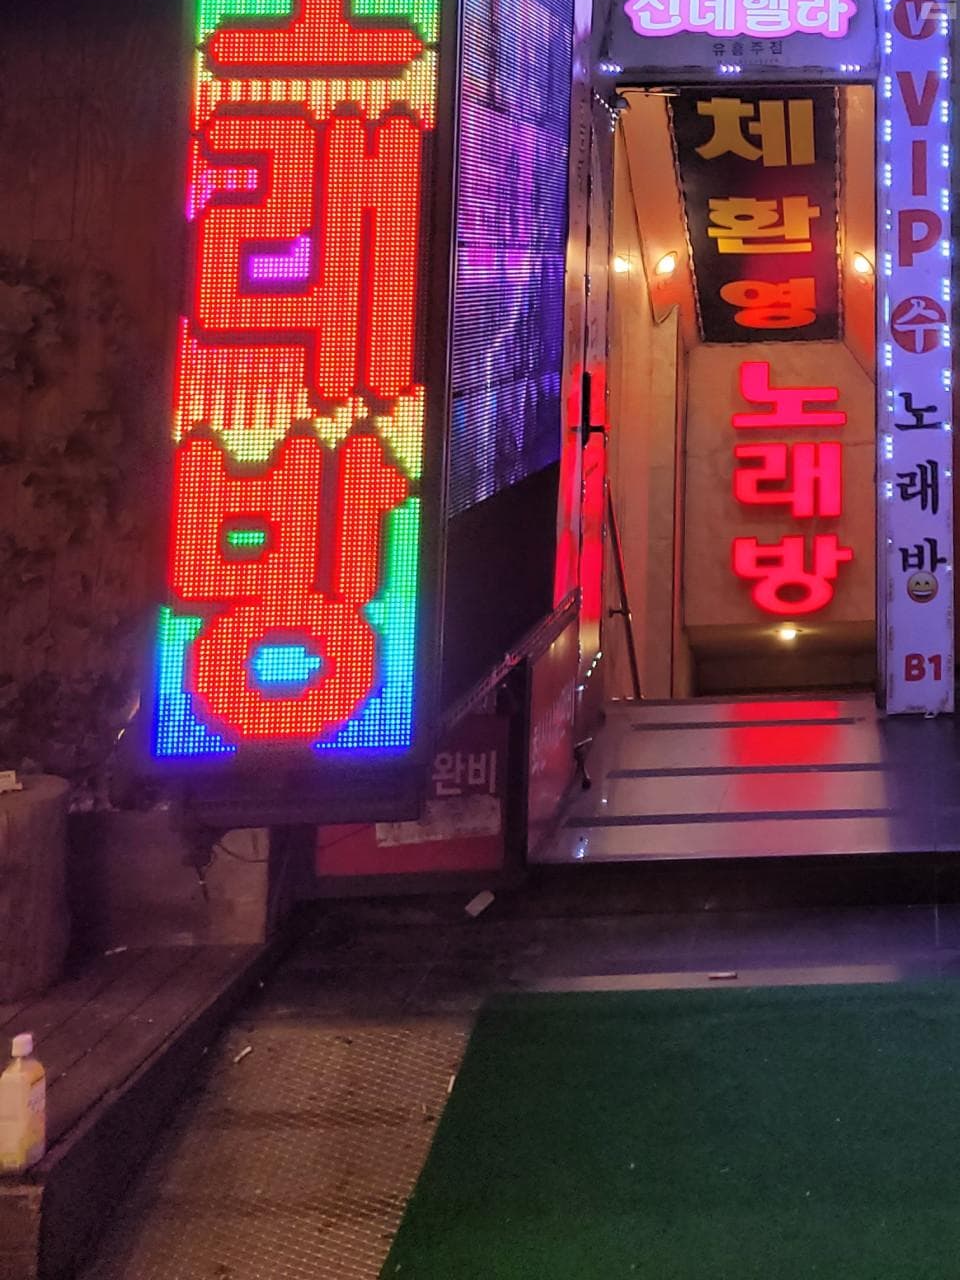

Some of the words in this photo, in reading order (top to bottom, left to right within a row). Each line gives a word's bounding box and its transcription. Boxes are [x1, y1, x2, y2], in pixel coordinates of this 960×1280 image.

[731, 360, 854, 616] 노래방
[904, 653, 943, 682] B1
[432, 750, 497, 796] 완비
